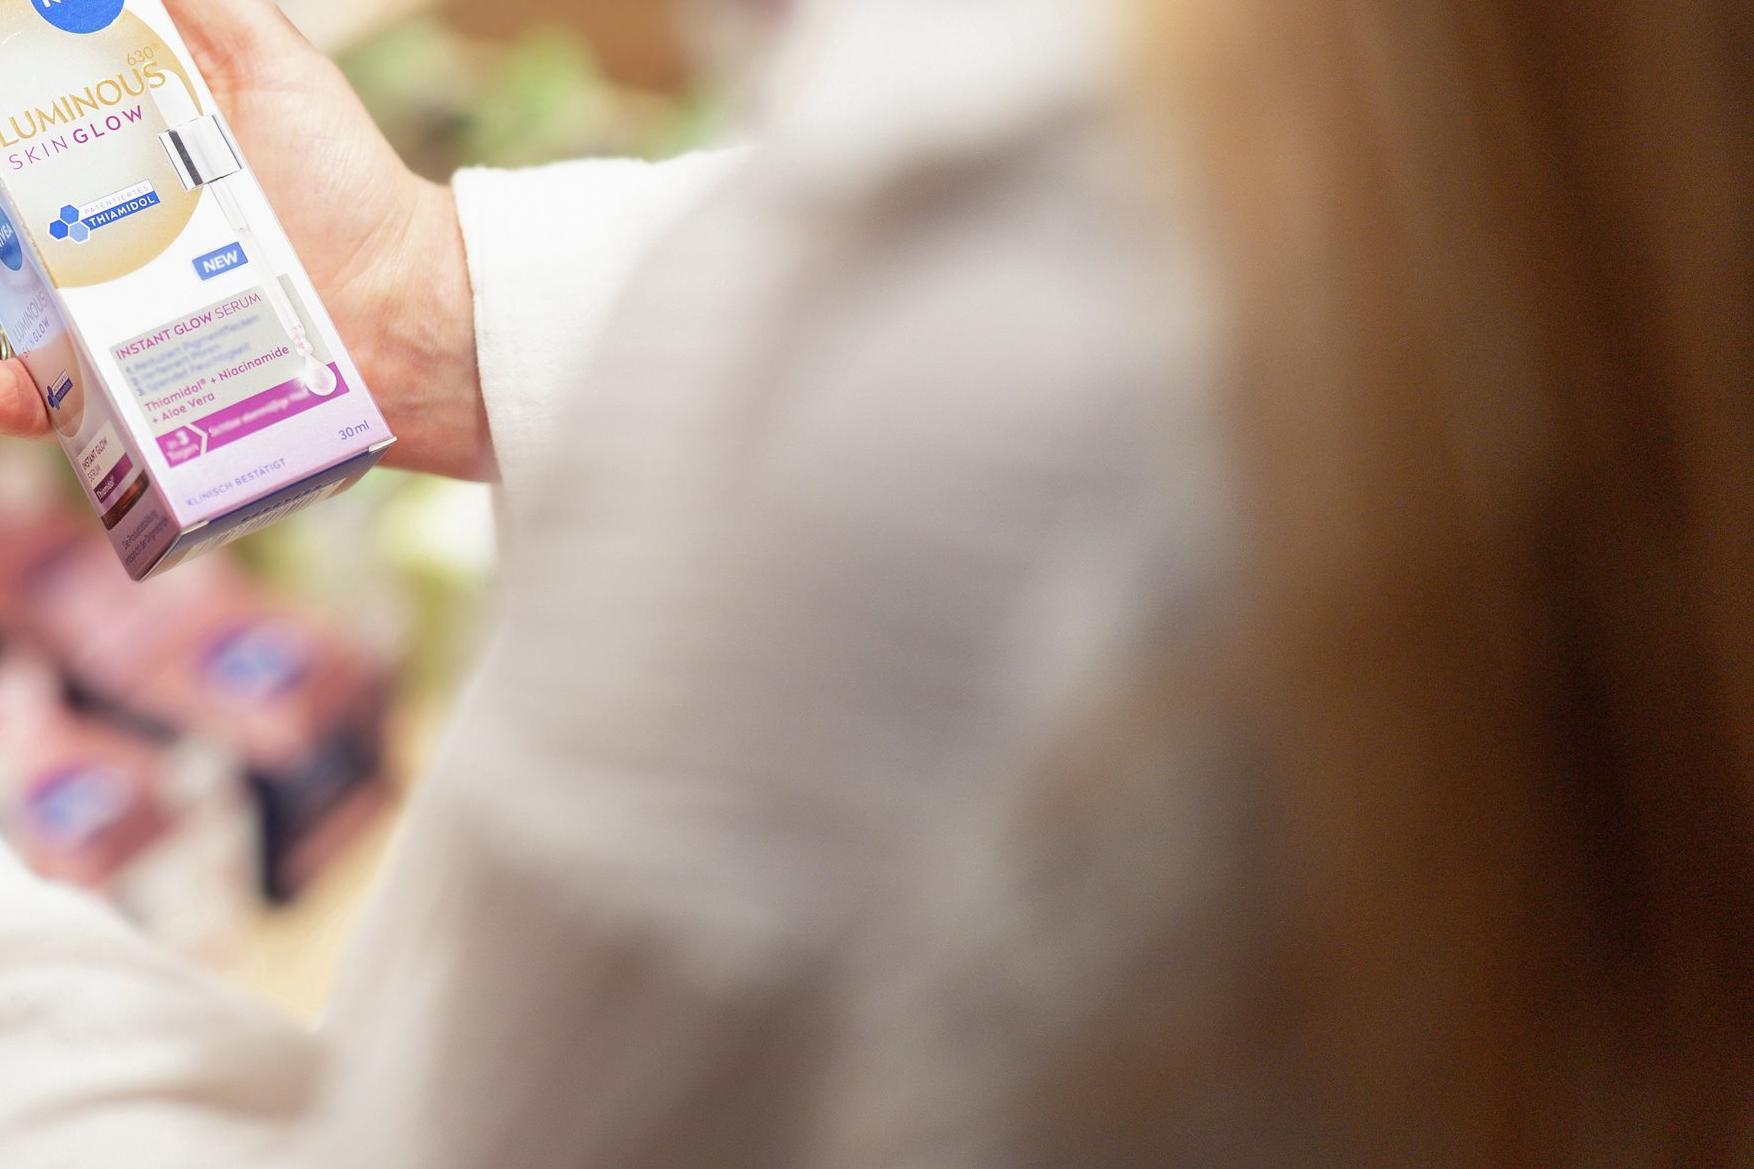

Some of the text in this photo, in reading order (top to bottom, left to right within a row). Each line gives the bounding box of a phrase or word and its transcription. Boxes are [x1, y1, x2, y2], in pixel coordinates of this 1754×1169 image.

[84, 185, 150, 215] PATENTIERTES
[89, 195, 155, 227] THIAMIDOL
[203, 251, 238, 274] NEW
[13, 291, 48, 343] LUMINOUS
[116, 293, 262, 361] INSTANT GLOW SERUM
[218, 345, 290, 381] Niacinamide
[161, 406, 187, 422] Aloe
[188, 393, 215, 408] Vera
[187, 476, 233, 508] KLINISCH
[235, 458, 286, 487] BESTÄTIGT
